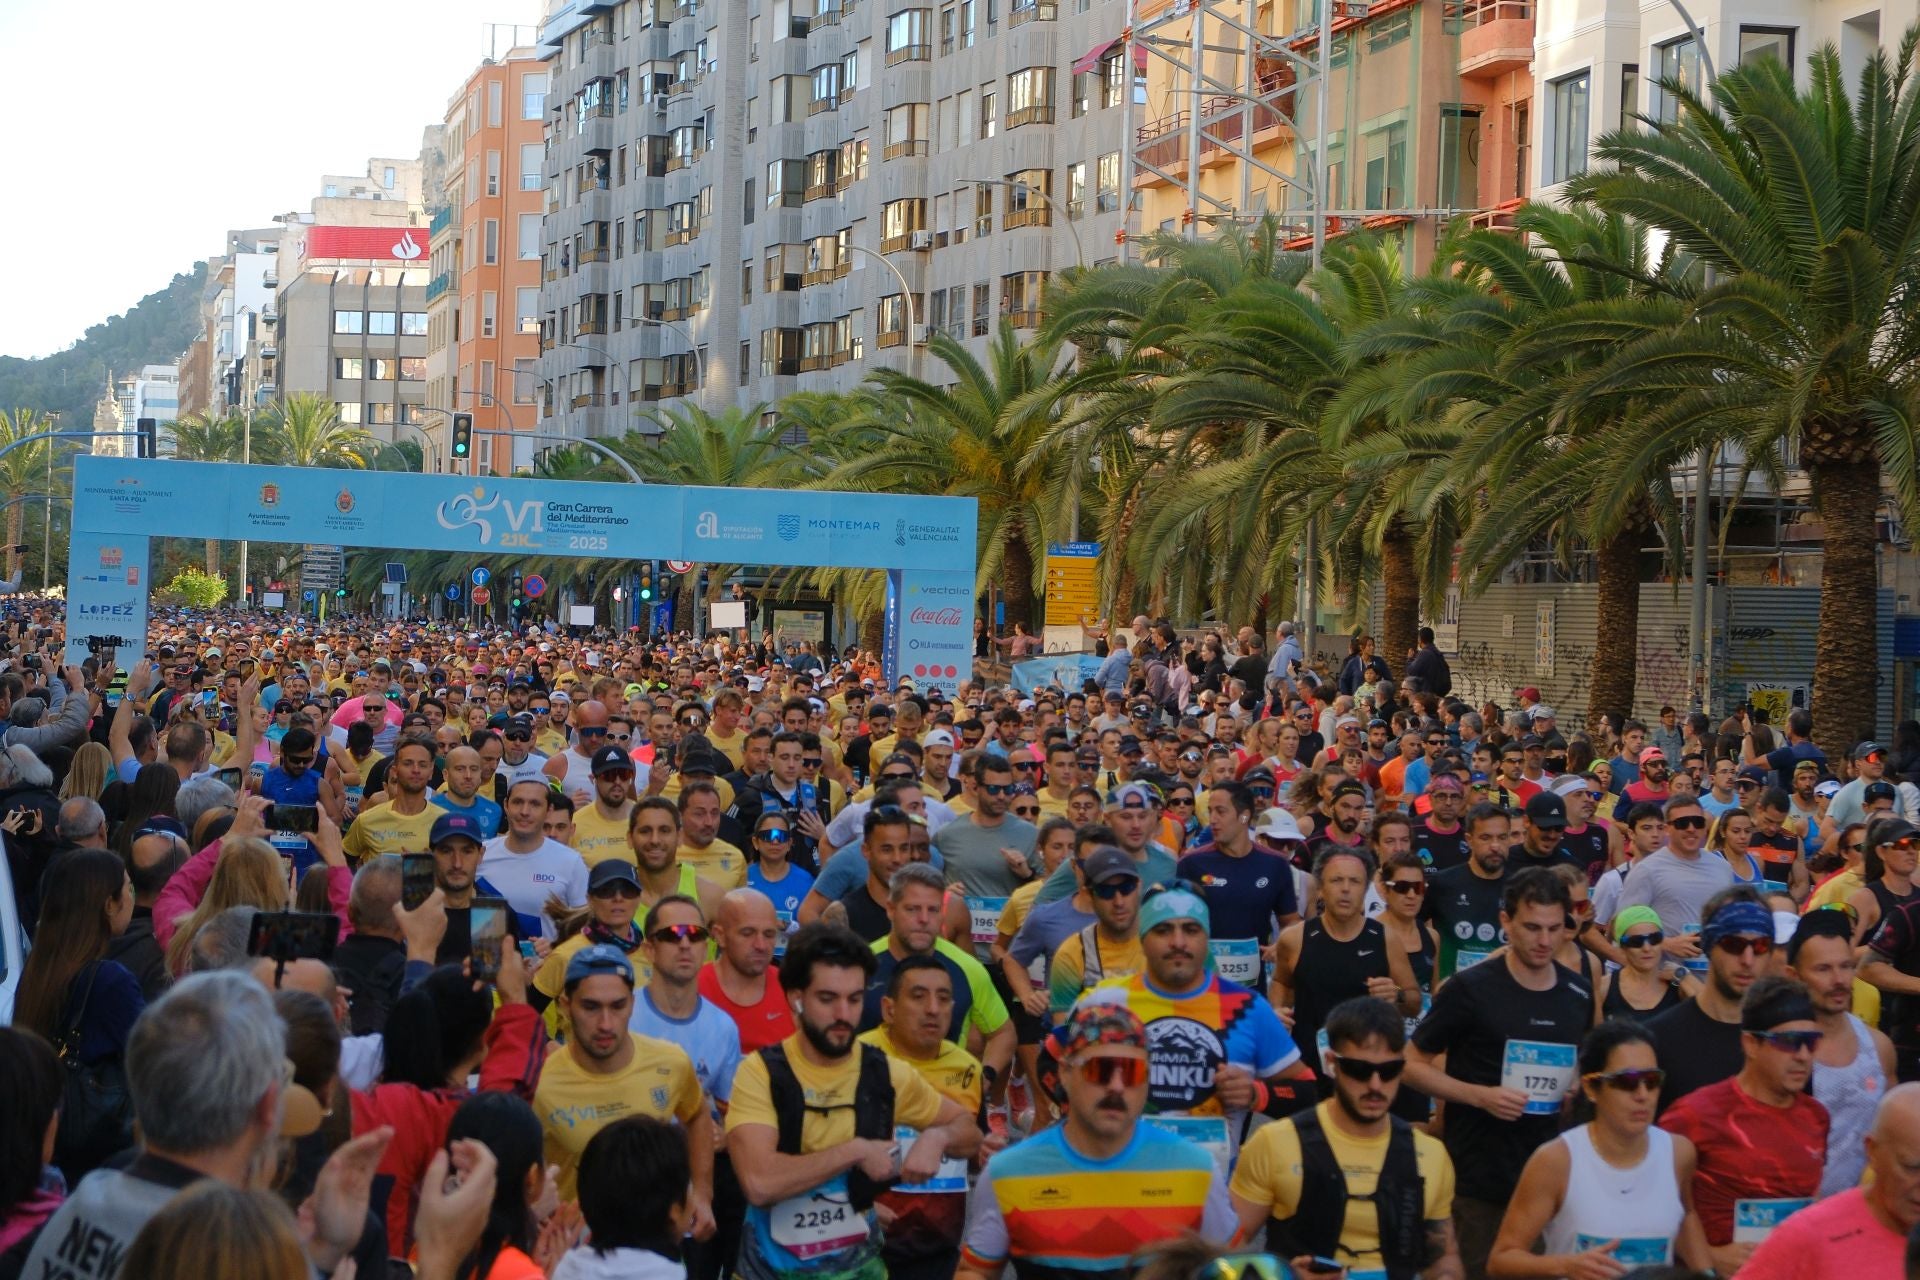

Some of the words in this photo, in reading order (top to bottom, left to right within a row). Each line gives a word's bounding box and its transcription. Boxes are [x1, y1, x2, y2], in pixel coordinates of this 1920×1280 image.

[547, 501, 573, 513] Gran
[574, 503, 613, 514] Carrera
[248, 512, 290, 521] Ayuntamiento
[547, 512, 562, 522] del
[564, 513, 629, 525] Mediterráneo
[808, 519, 881, 531] MONTEMAR
[908, 525, 960, 534] GENERALITAT
[569, 536, 608, 550] 2025
[909, 533, 959, 542] VALENCIANA
[921, 586, 970, 595] vectalia
[915, 679, 957, 689] Securitas
[535, 873, 557, 883] BDO
[1221, 963, 1249, 974] 3253
[1150, 1064, 1216, 1088] INKU
[1524, 1076, 1558, 1090] 1778
[794, 1208, 846, 1229] 2284
